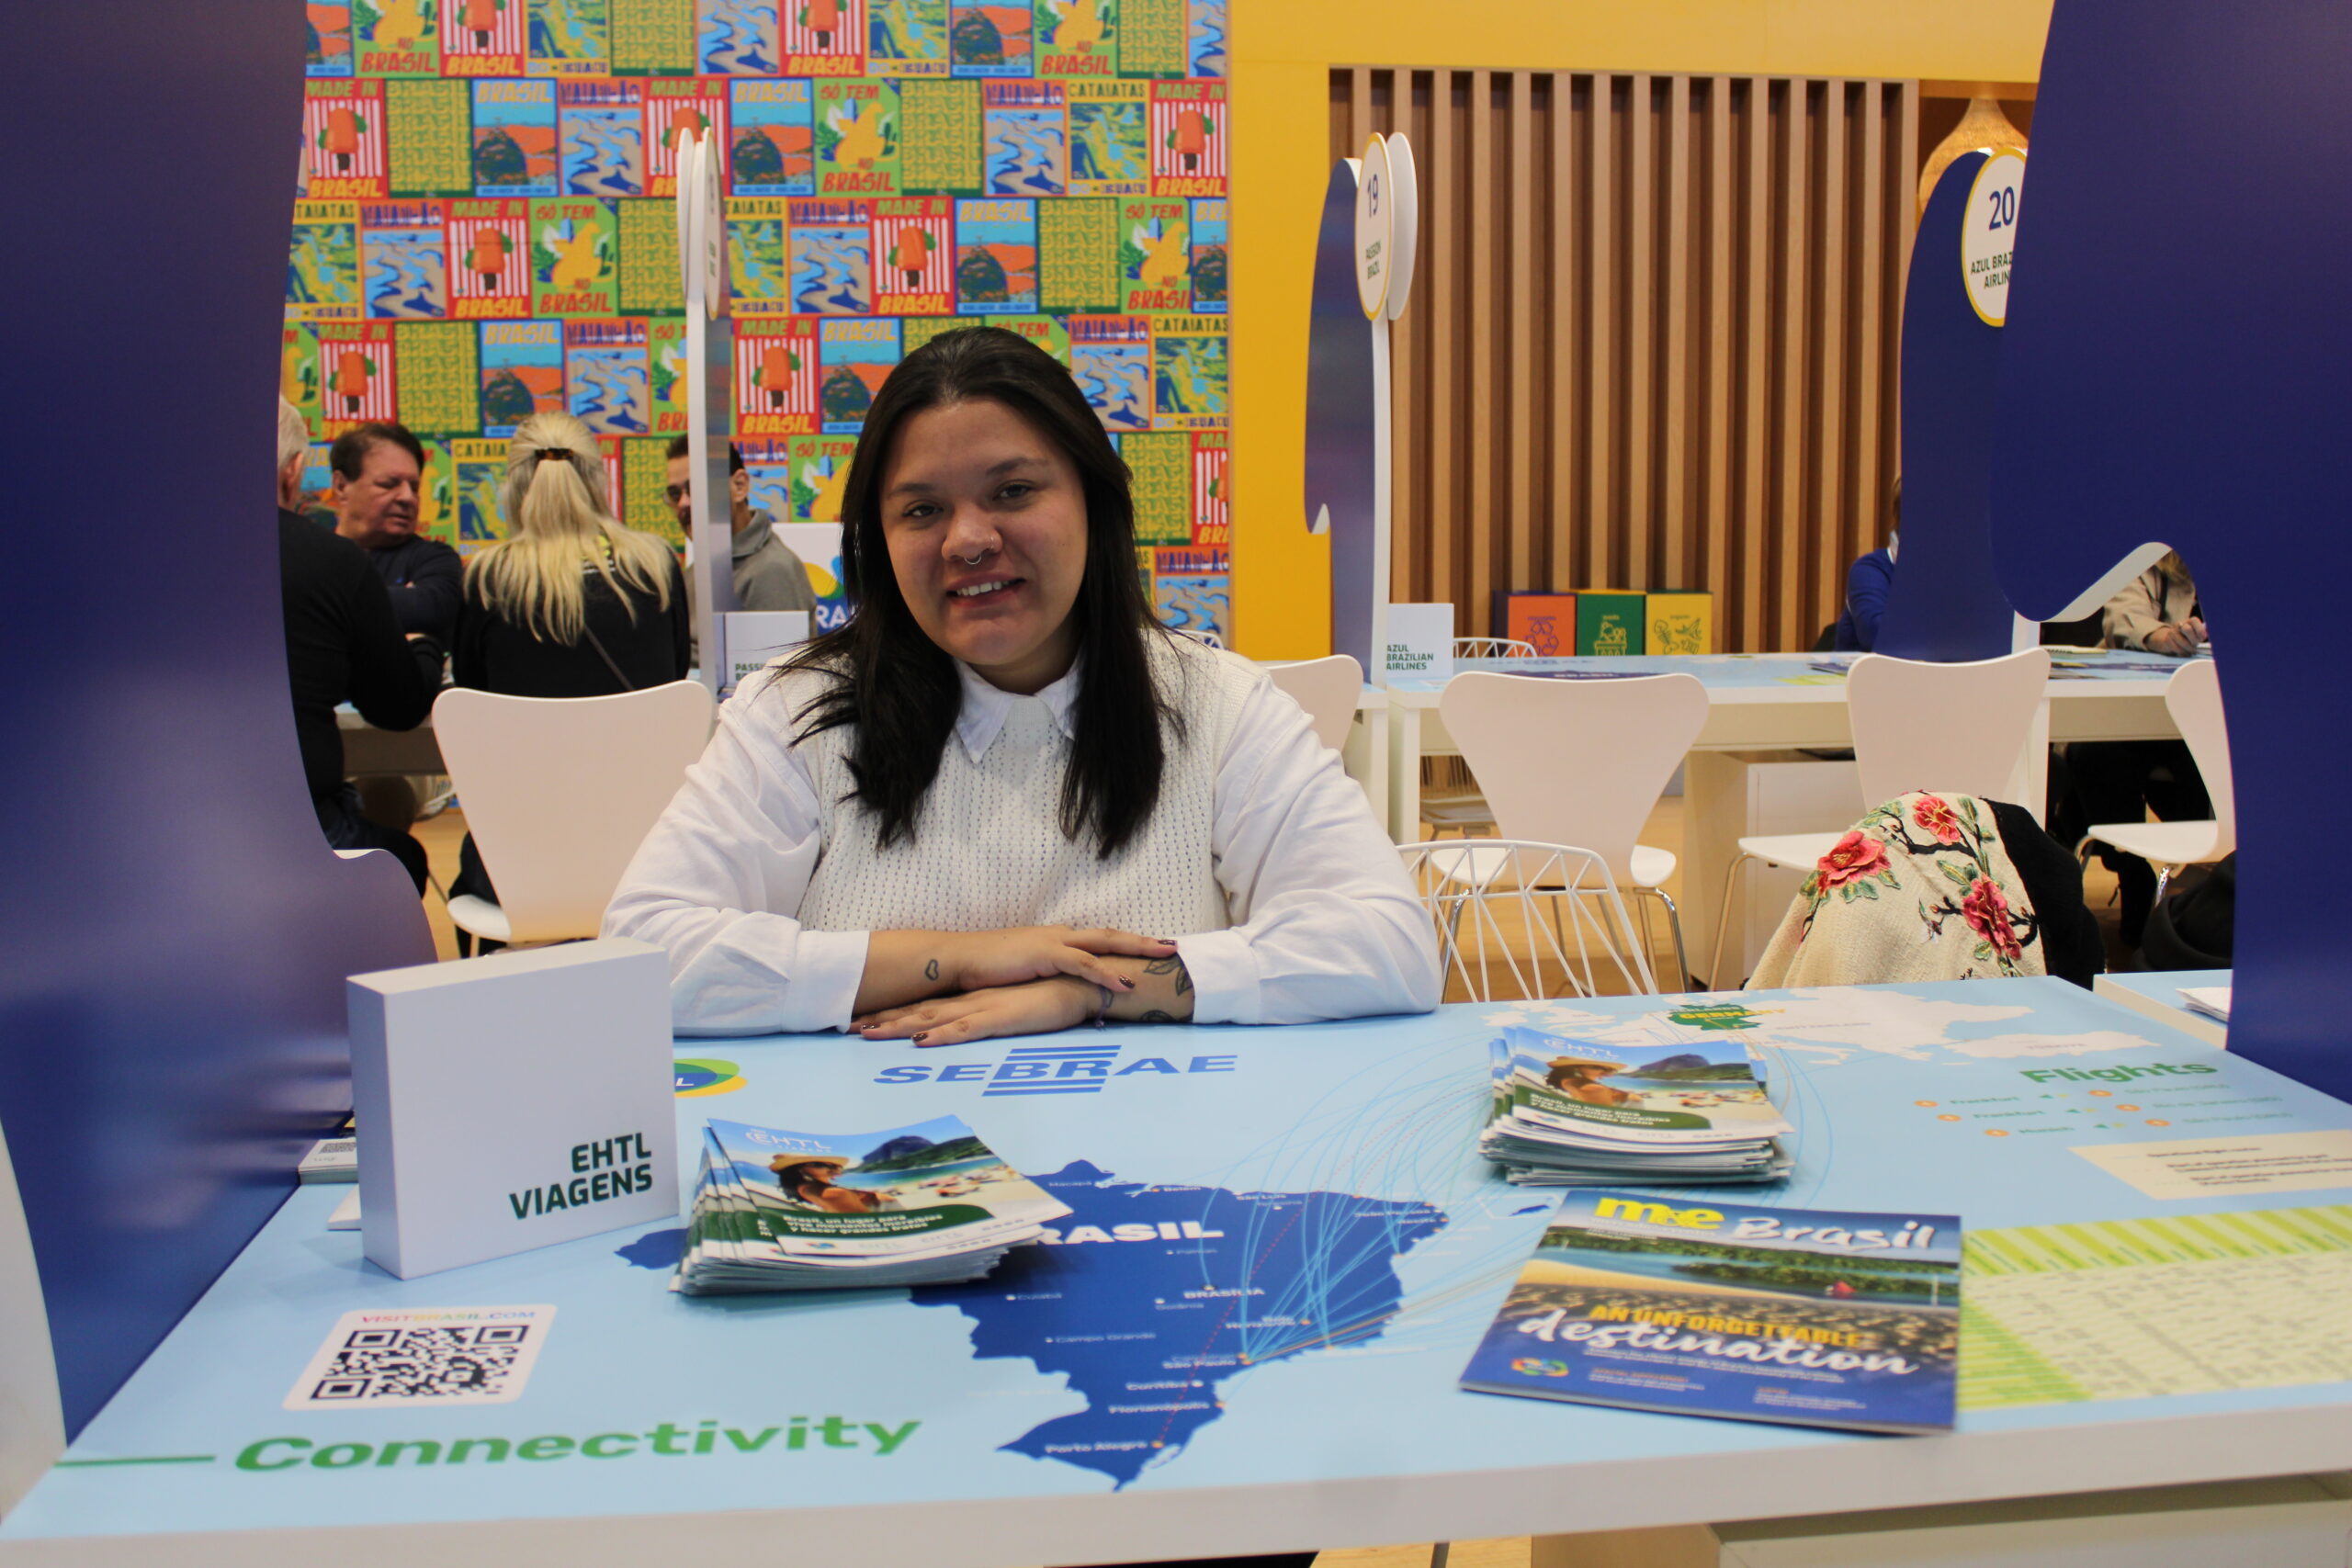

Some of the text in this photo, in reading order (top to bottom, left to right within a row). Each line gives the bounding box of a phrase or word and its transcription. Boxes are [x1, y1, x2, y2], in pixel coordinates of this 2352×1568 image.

[361, 51, 436, 73] BRASIL
[446, 56, 522, 75] BRASIL
[787, 56, 861, 74] BRASIL
[1040, 55, 1114, 75] BRASIL
[476, 82, 553, 104] BRASIL
[650, 81, 722, 96] MADE IN
[734, 82, 809, 103] BRASIL
[819, 83, 880, 100] SÓ TEM
[1156, 84, 1226, 99] MADE IN
[309, 178, 383, 197] BRASIL
[821, 172, 897, 192] BRASIL
[1155, 178, 1226, 197] BRASIL
[1367, 174, 1379, 218] 19
[451, 201, 525, 217] MADE IN
[536, 203, 596, 220] SÓ TEM
[876, 199, 947, 216] MADE IN
[959, 201, 1033, 222] BRASIL
[1125, 203, 1146, 220] SÓ
[1150, 204, 1183, 220] TEM
[1989, 186, 2016, 231] 20
[1971, 251, 2013, 275] AZUL BRAZ
[1984, 272, 2009, 289] AIRLIN
[454, 299, 528, 318] BRASIL
[538, 293, 614, 314] BRASIL
[877, 295, 950, 314] BRASIL
[319, 324, 388, 341] MADE IN
[483, 323, 560, 344] BRASIL
[741, 320, 812, 335] MADE IN
[823, 321, 898, 342] BRASIL
[1017, 322, 1049, 338] TEM
[742, 415, 814, 434] BRASIL
[797, 440, 816, 457] SÓ
[1385, 652, 1434, 662] BRAZILIAN
[1386, 645, 1409, 653] AZUL
[1385, 661, 1428, 671] AIRLINES
[874, 1055, 1238, 1085] SEBRAE
[2019, 1060, 2218, 1084] Flights
[745, 1128, 832, 1151] EHTL
[571, 1132, 651, 1173] EHTL
[509, 1164, 653, 1220] VIAGENS
[1040, 1220, 1225, 1246] RASIL
[1731, 1215, 1936, 1252] Brasil
[362, 1312, 537, 1324] VISITBRASIL.COM
[1589, 1303, 1865, 1348] AN UNFORGETTABLE
[1517, 1308, 1922, 1376] destination
[1125, 1380, 1189, 1391] Curitiba
[235, 1416, 922, 1472] Connectivity
[1045, 1443, 1092, 1454] Porto
